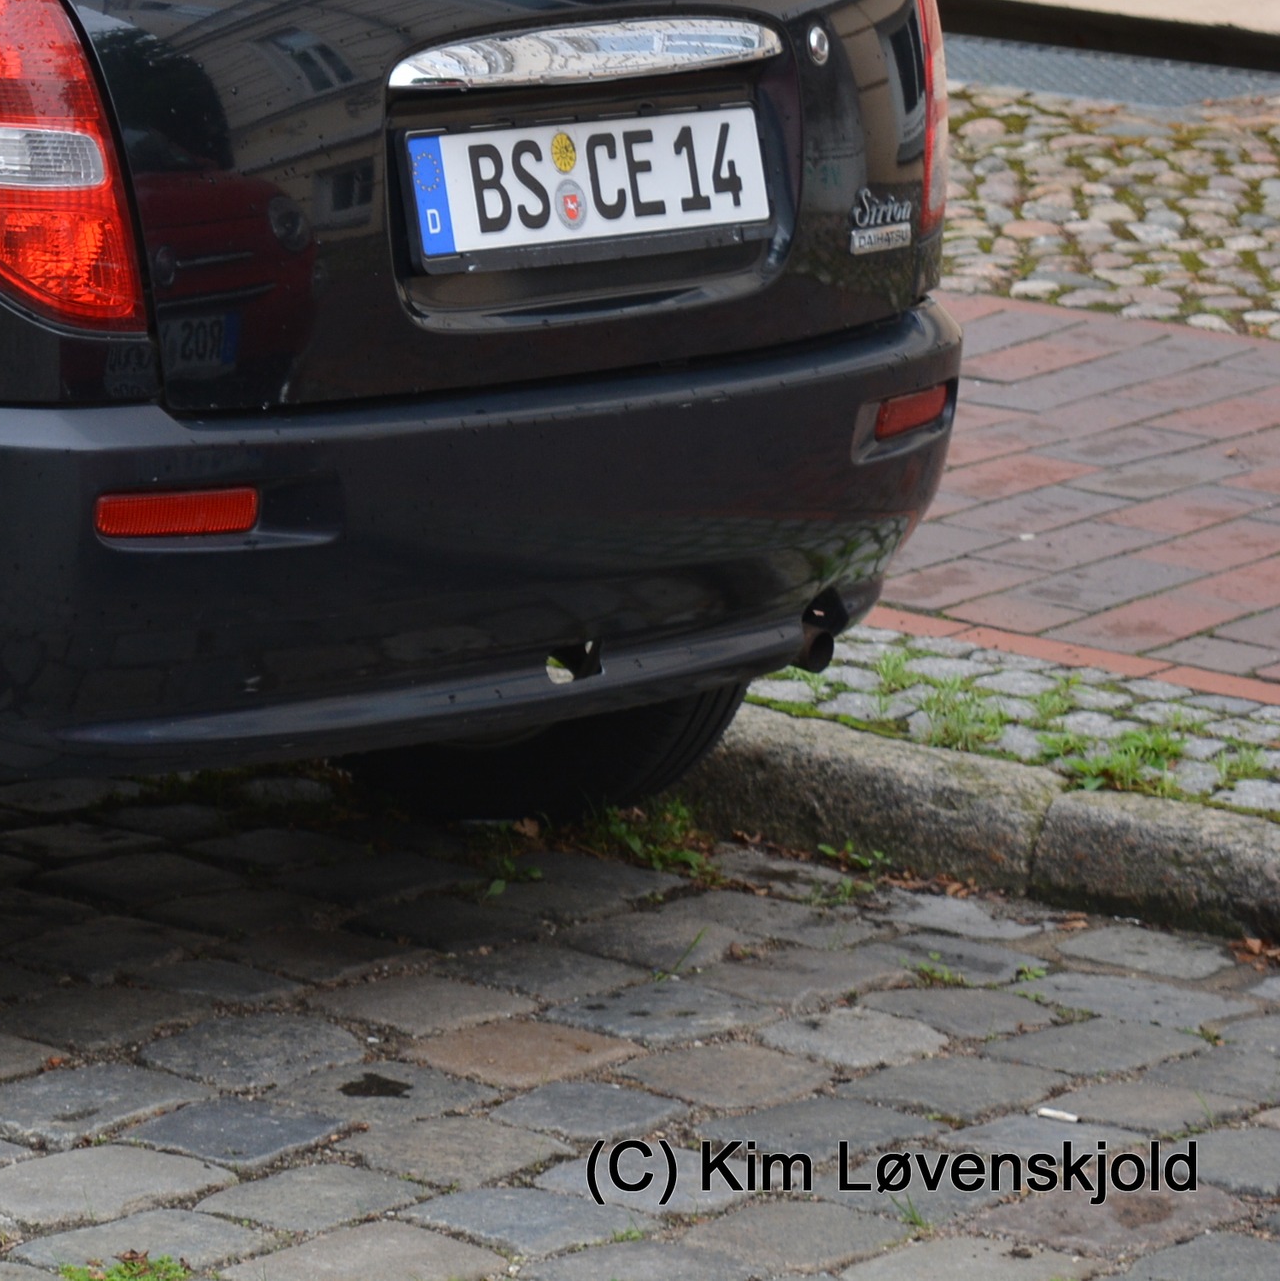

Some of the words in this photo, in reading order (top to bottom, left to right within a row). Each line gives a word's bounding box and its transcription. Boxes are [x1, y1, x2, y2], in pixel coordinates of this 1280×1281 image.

[467, 139, 551, 234] BS
[586, 129, 667, 220] CE
[673, 122, 743, 212] 14
[426, 208, 441, 234] D
[851, 187, 912, 228] Sirion
[858, 229, 909, 248] DAIHATSU
